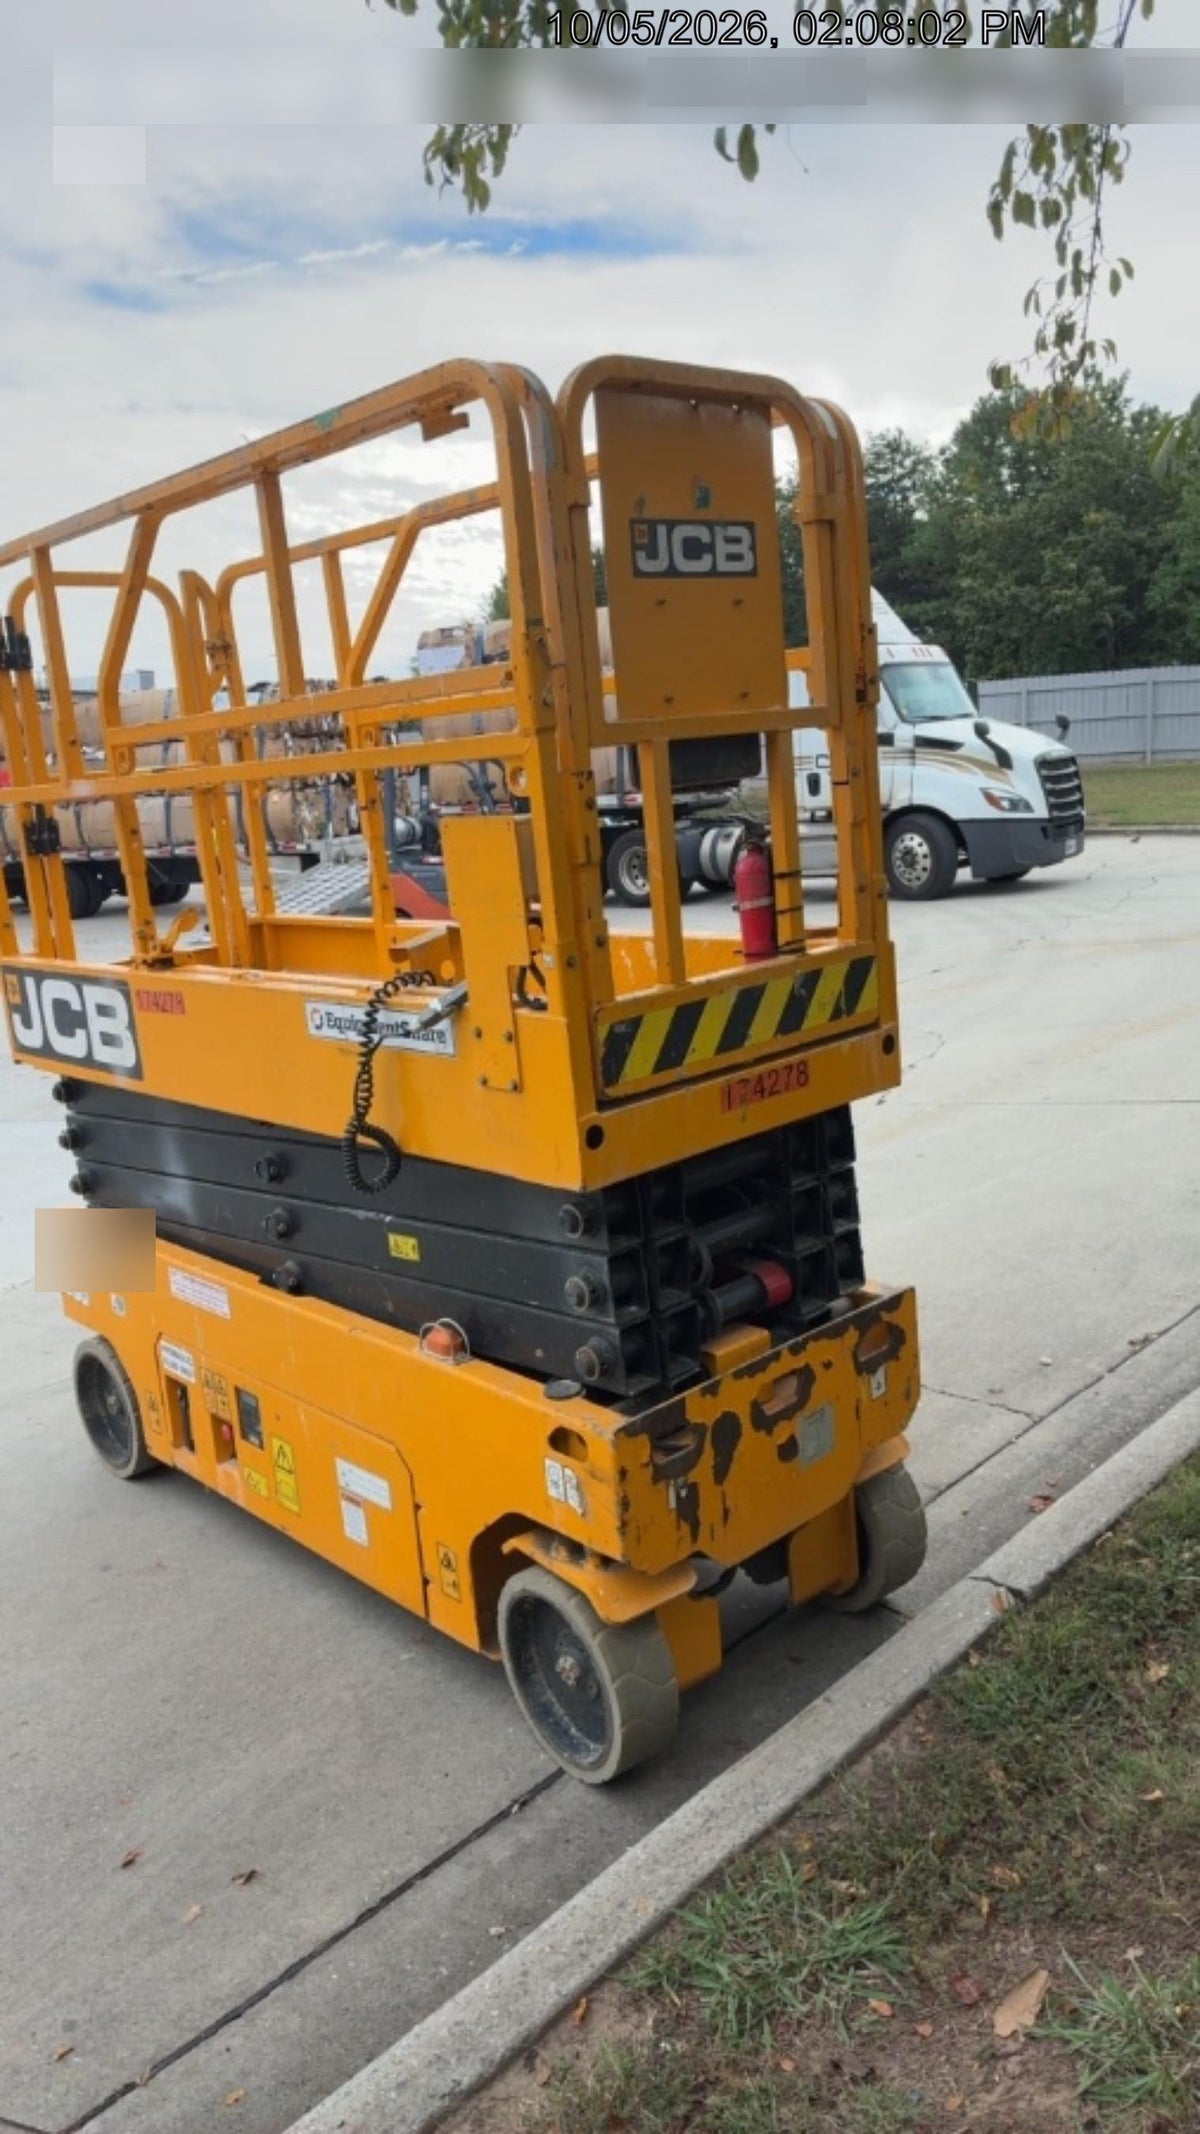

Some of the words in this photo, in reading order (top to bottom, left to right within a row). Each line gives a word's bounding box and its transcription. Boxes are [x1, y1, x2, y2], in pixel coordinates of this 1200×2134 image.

[634, 523, 755, 573] JCB
[11, 975, 137, 1069] JCB
[725, 1060, 809, 1111] 174278
